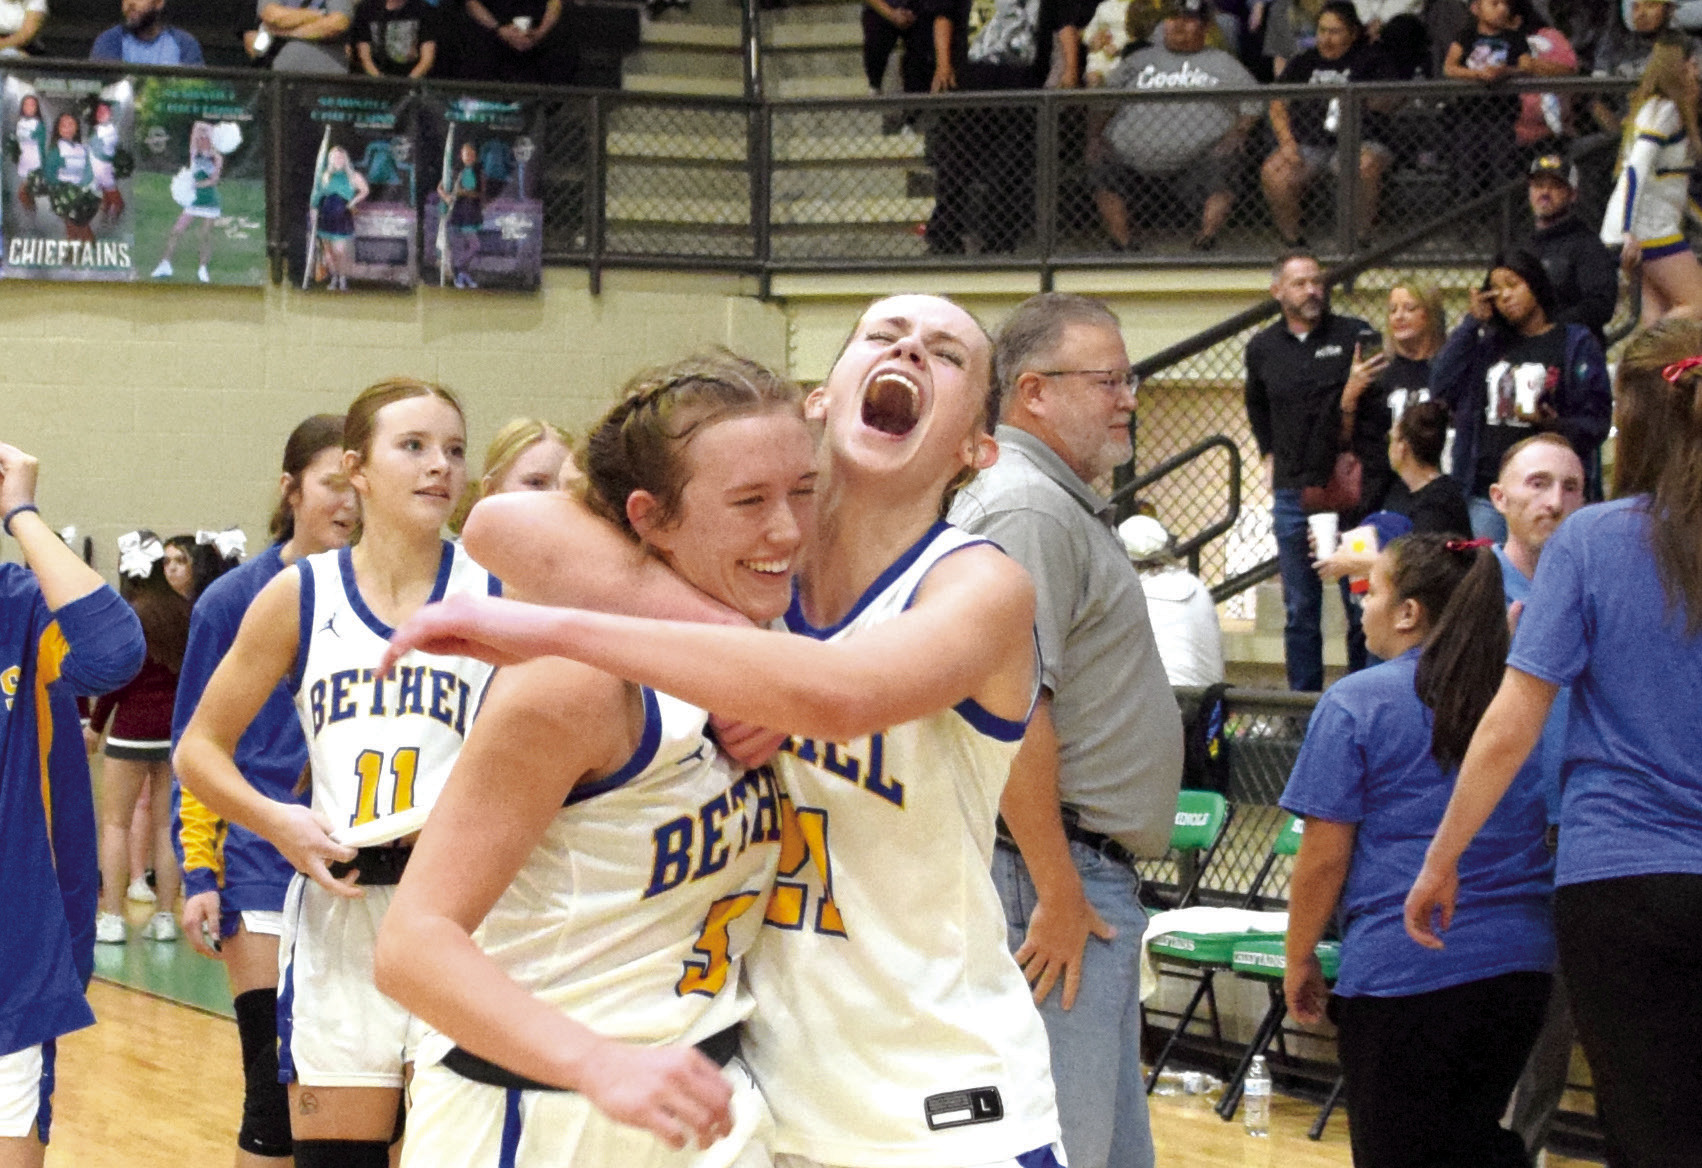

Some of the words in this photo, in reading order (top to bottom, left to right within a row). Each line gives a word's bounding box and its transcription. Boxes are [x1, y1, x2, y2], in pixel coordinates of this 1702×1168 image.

[8, 237, 132, 268] CHIEFTAINS
[349, 746, 421, 828] 11
[980, 1097, 991, 1112] L
